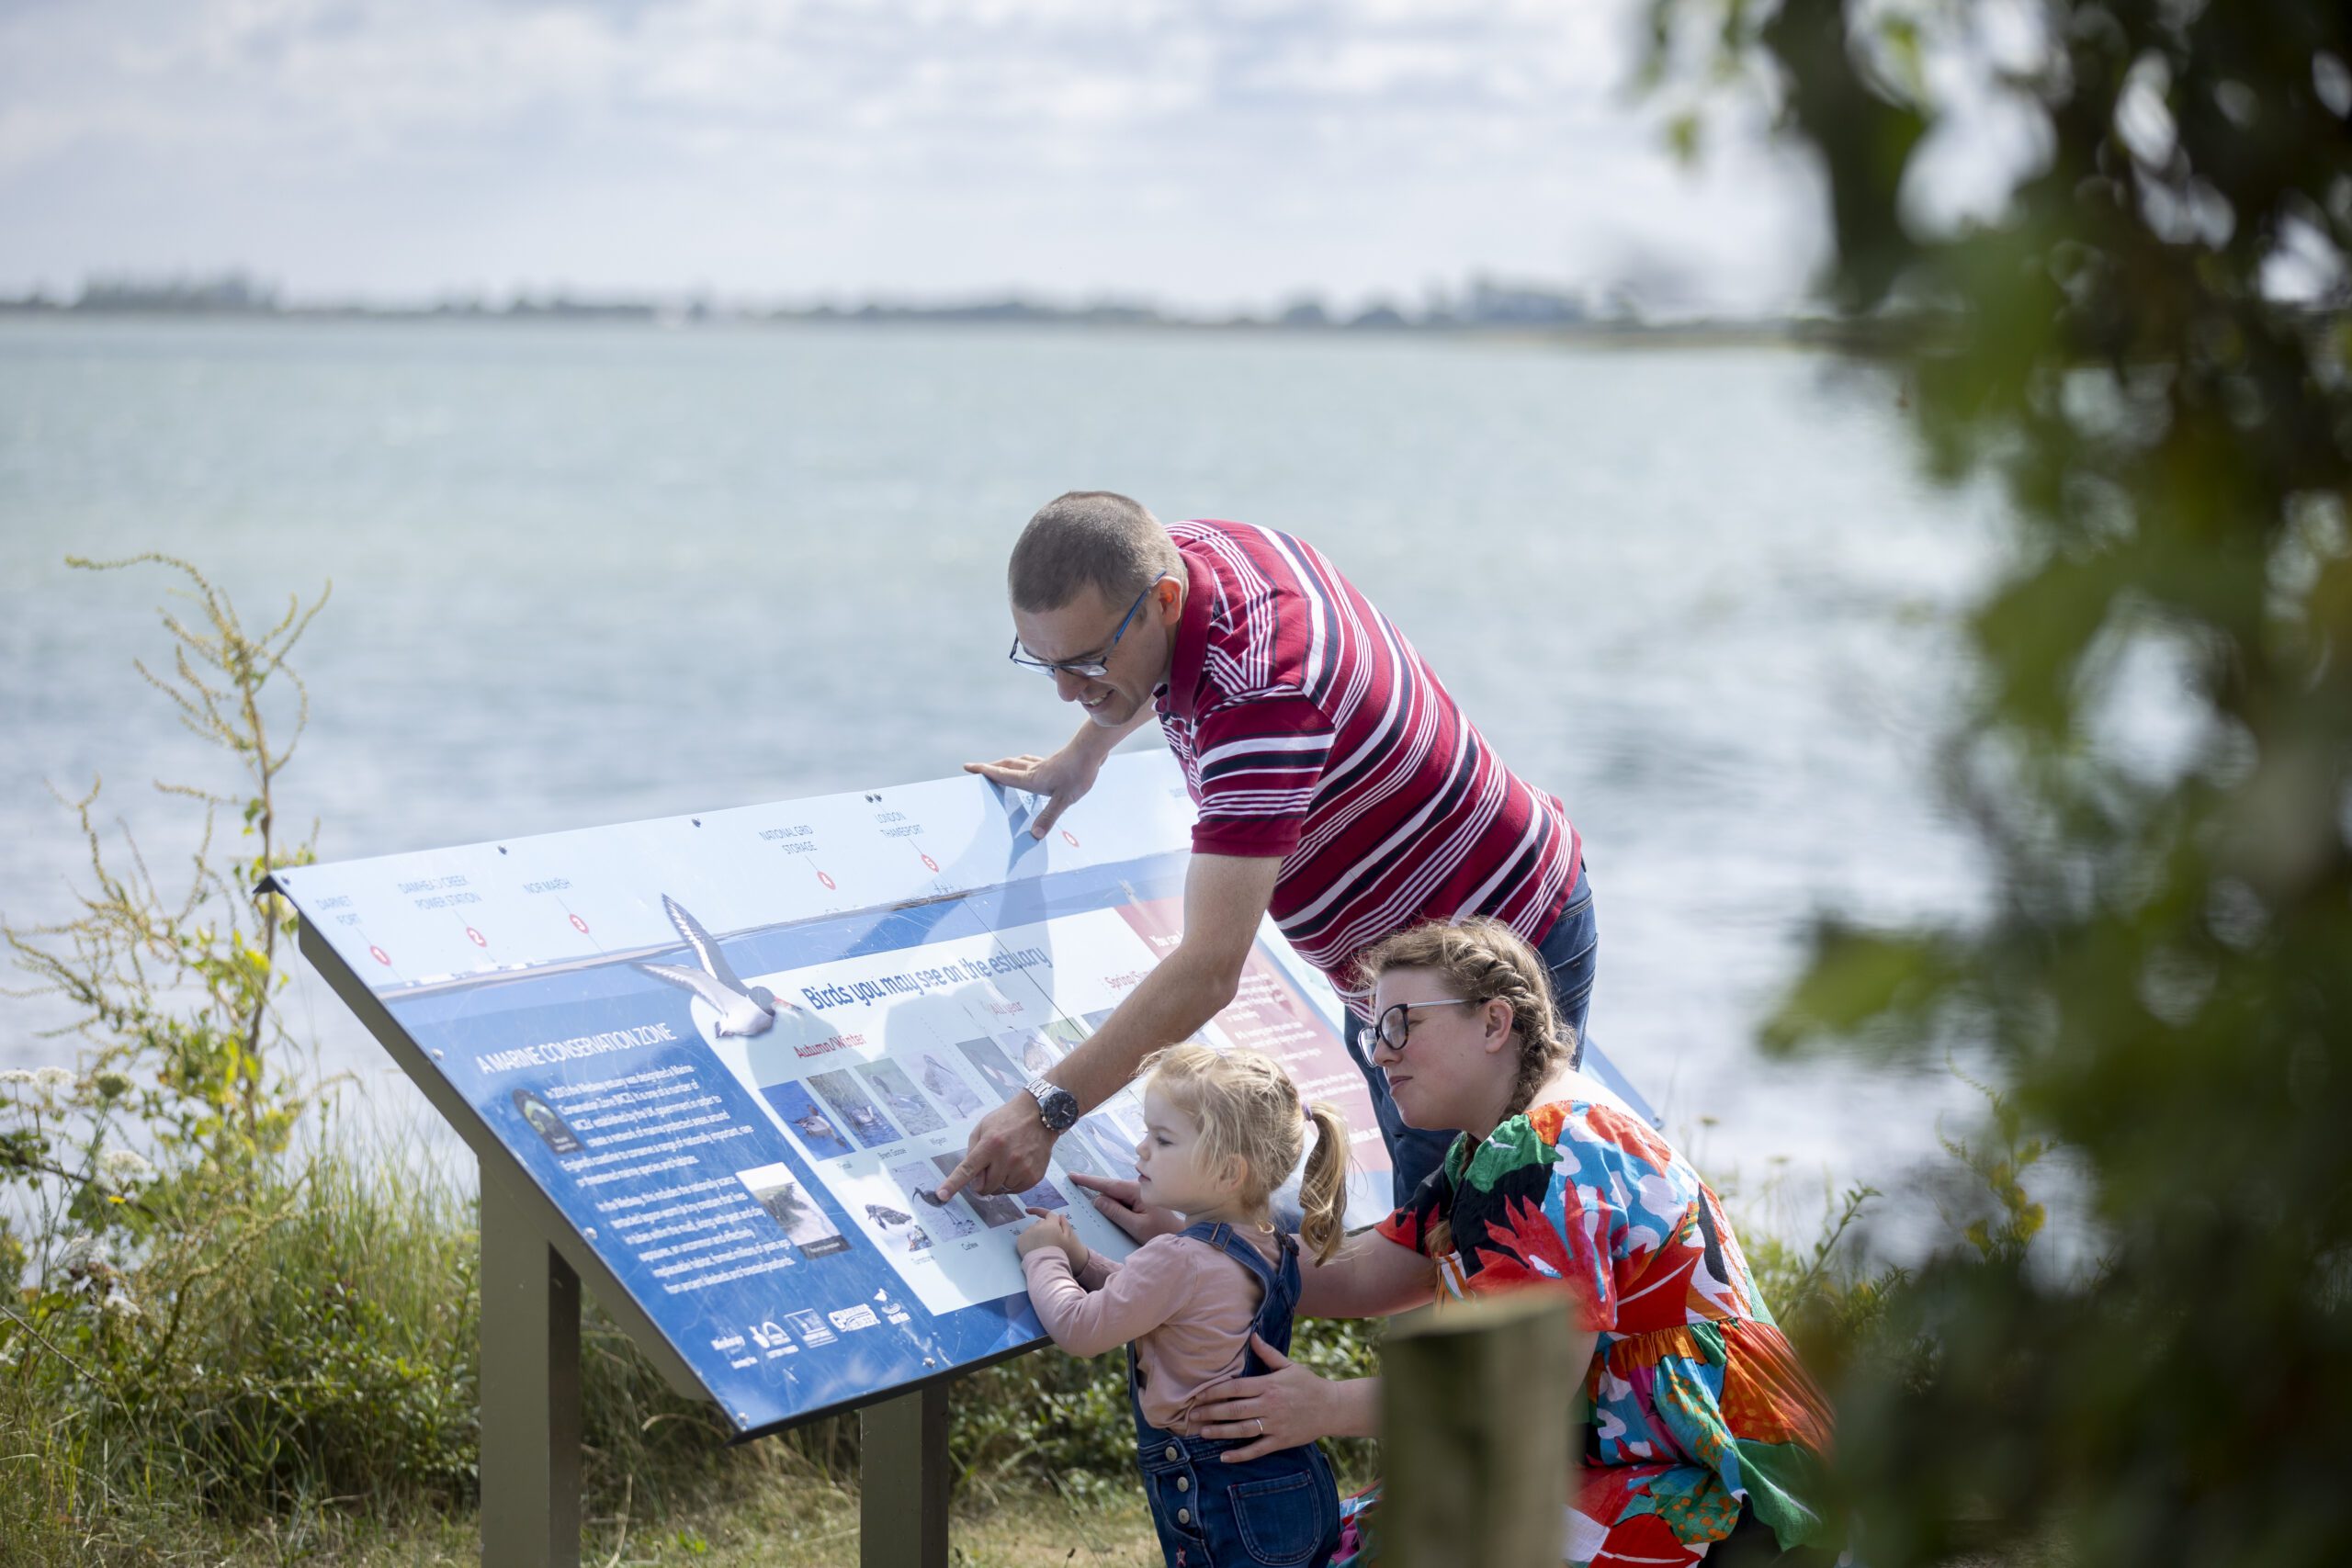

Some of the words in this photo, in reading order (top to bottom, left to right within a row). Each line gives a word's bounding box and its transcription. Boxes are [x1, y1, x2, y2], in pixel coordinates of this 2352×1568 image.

[875, 810, 907, 824] LONDON
[759, 827, 797, 841] NATIONAL
[794, 824, 814, 838] GRID
[782, 840, 818, 855] STORAGE
[469, 929, 486, 946] 2
[801, 983, 854, 1010] Birds
[848, 979, 886, 1007] you
[879, 973, 925, 996] may
[917, 967, 947, 988] see
[943, 964, 968, 983] on
[958, 957, 993, 980] the
[987, 947, 1053, 977] estuary
[632, 1022, 678, 1046] ZONE
[794, 1032, 867, 1058] Autumn/Winter
[537, 1027, 642, 1064] CONSERVATION
[476, 1055, 496, 1075] A
[484, 1045, 548, 1073] MARINE
